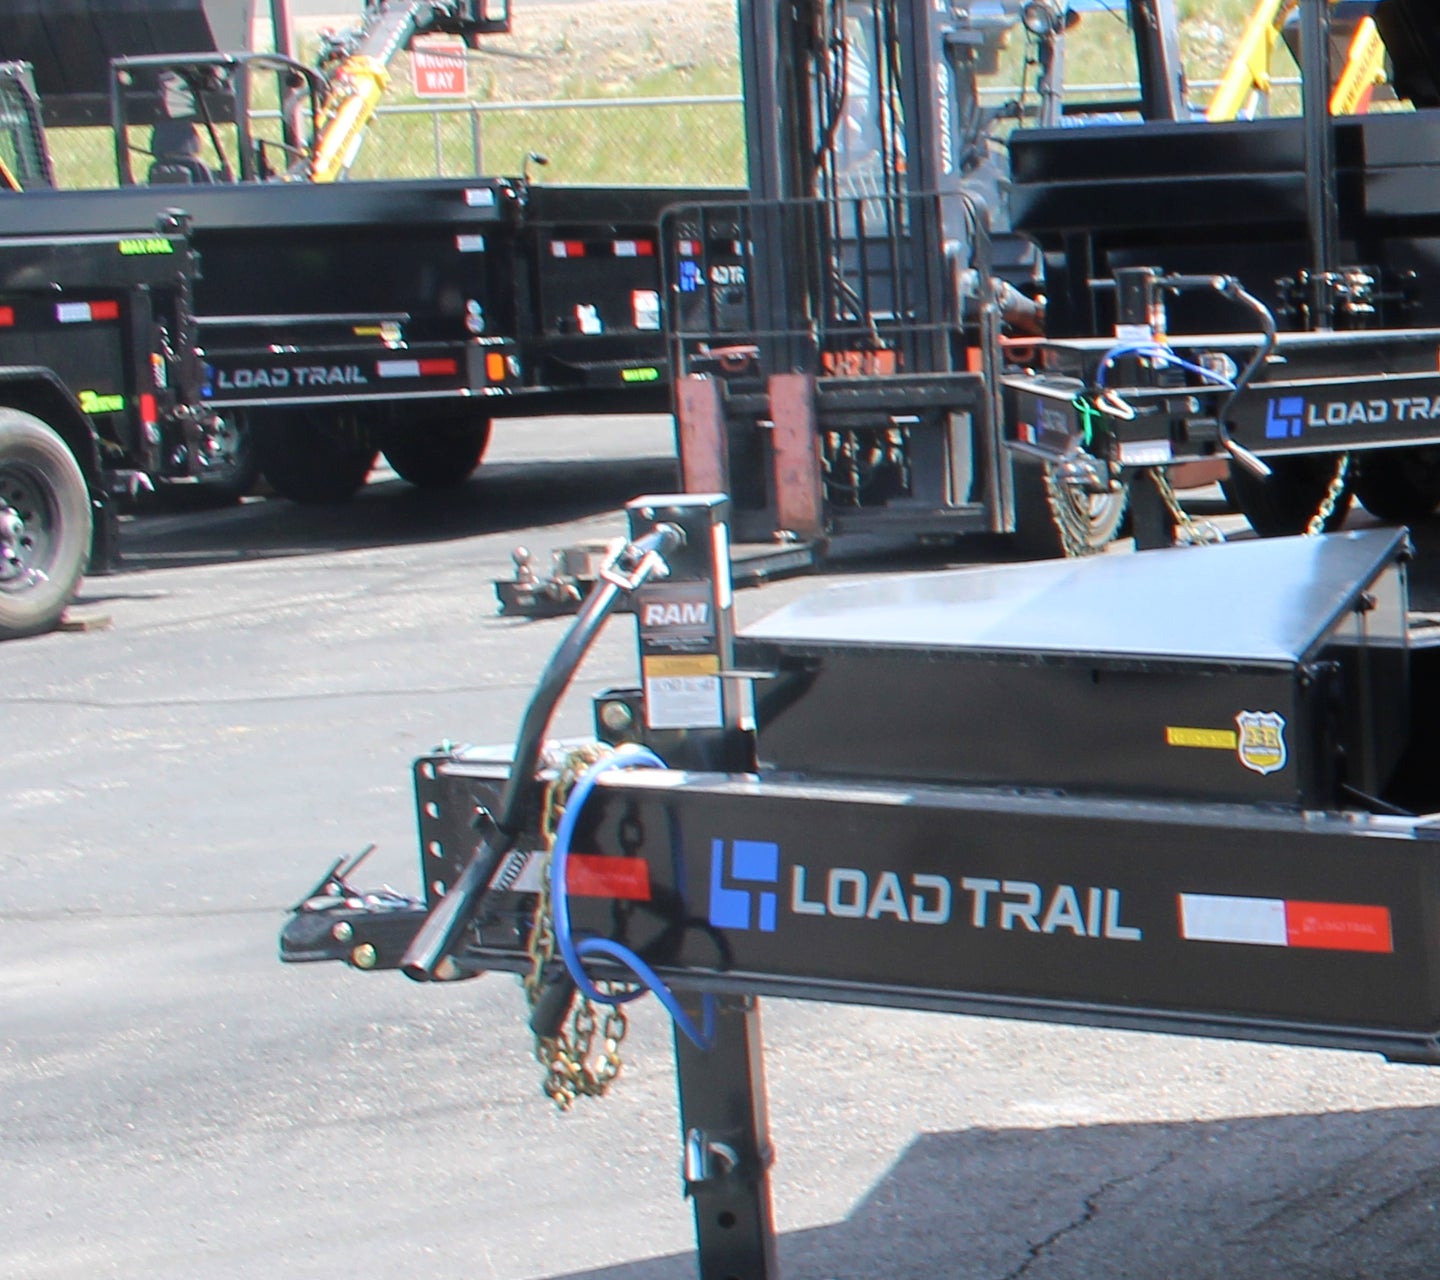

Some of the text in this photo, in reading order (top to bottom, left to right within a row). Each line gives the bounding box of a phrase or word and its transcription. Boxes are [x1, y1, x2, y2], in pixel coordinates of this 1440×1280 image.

[425, 70, 455, 90] WAY
[217, 364, 369, 390] LOAD TRAIL
[1307, 399, 1389, 427] LOAD
[645, 602, 708, 626] RAM
[789, 864, 1142, 941] LOAD TRAIL
